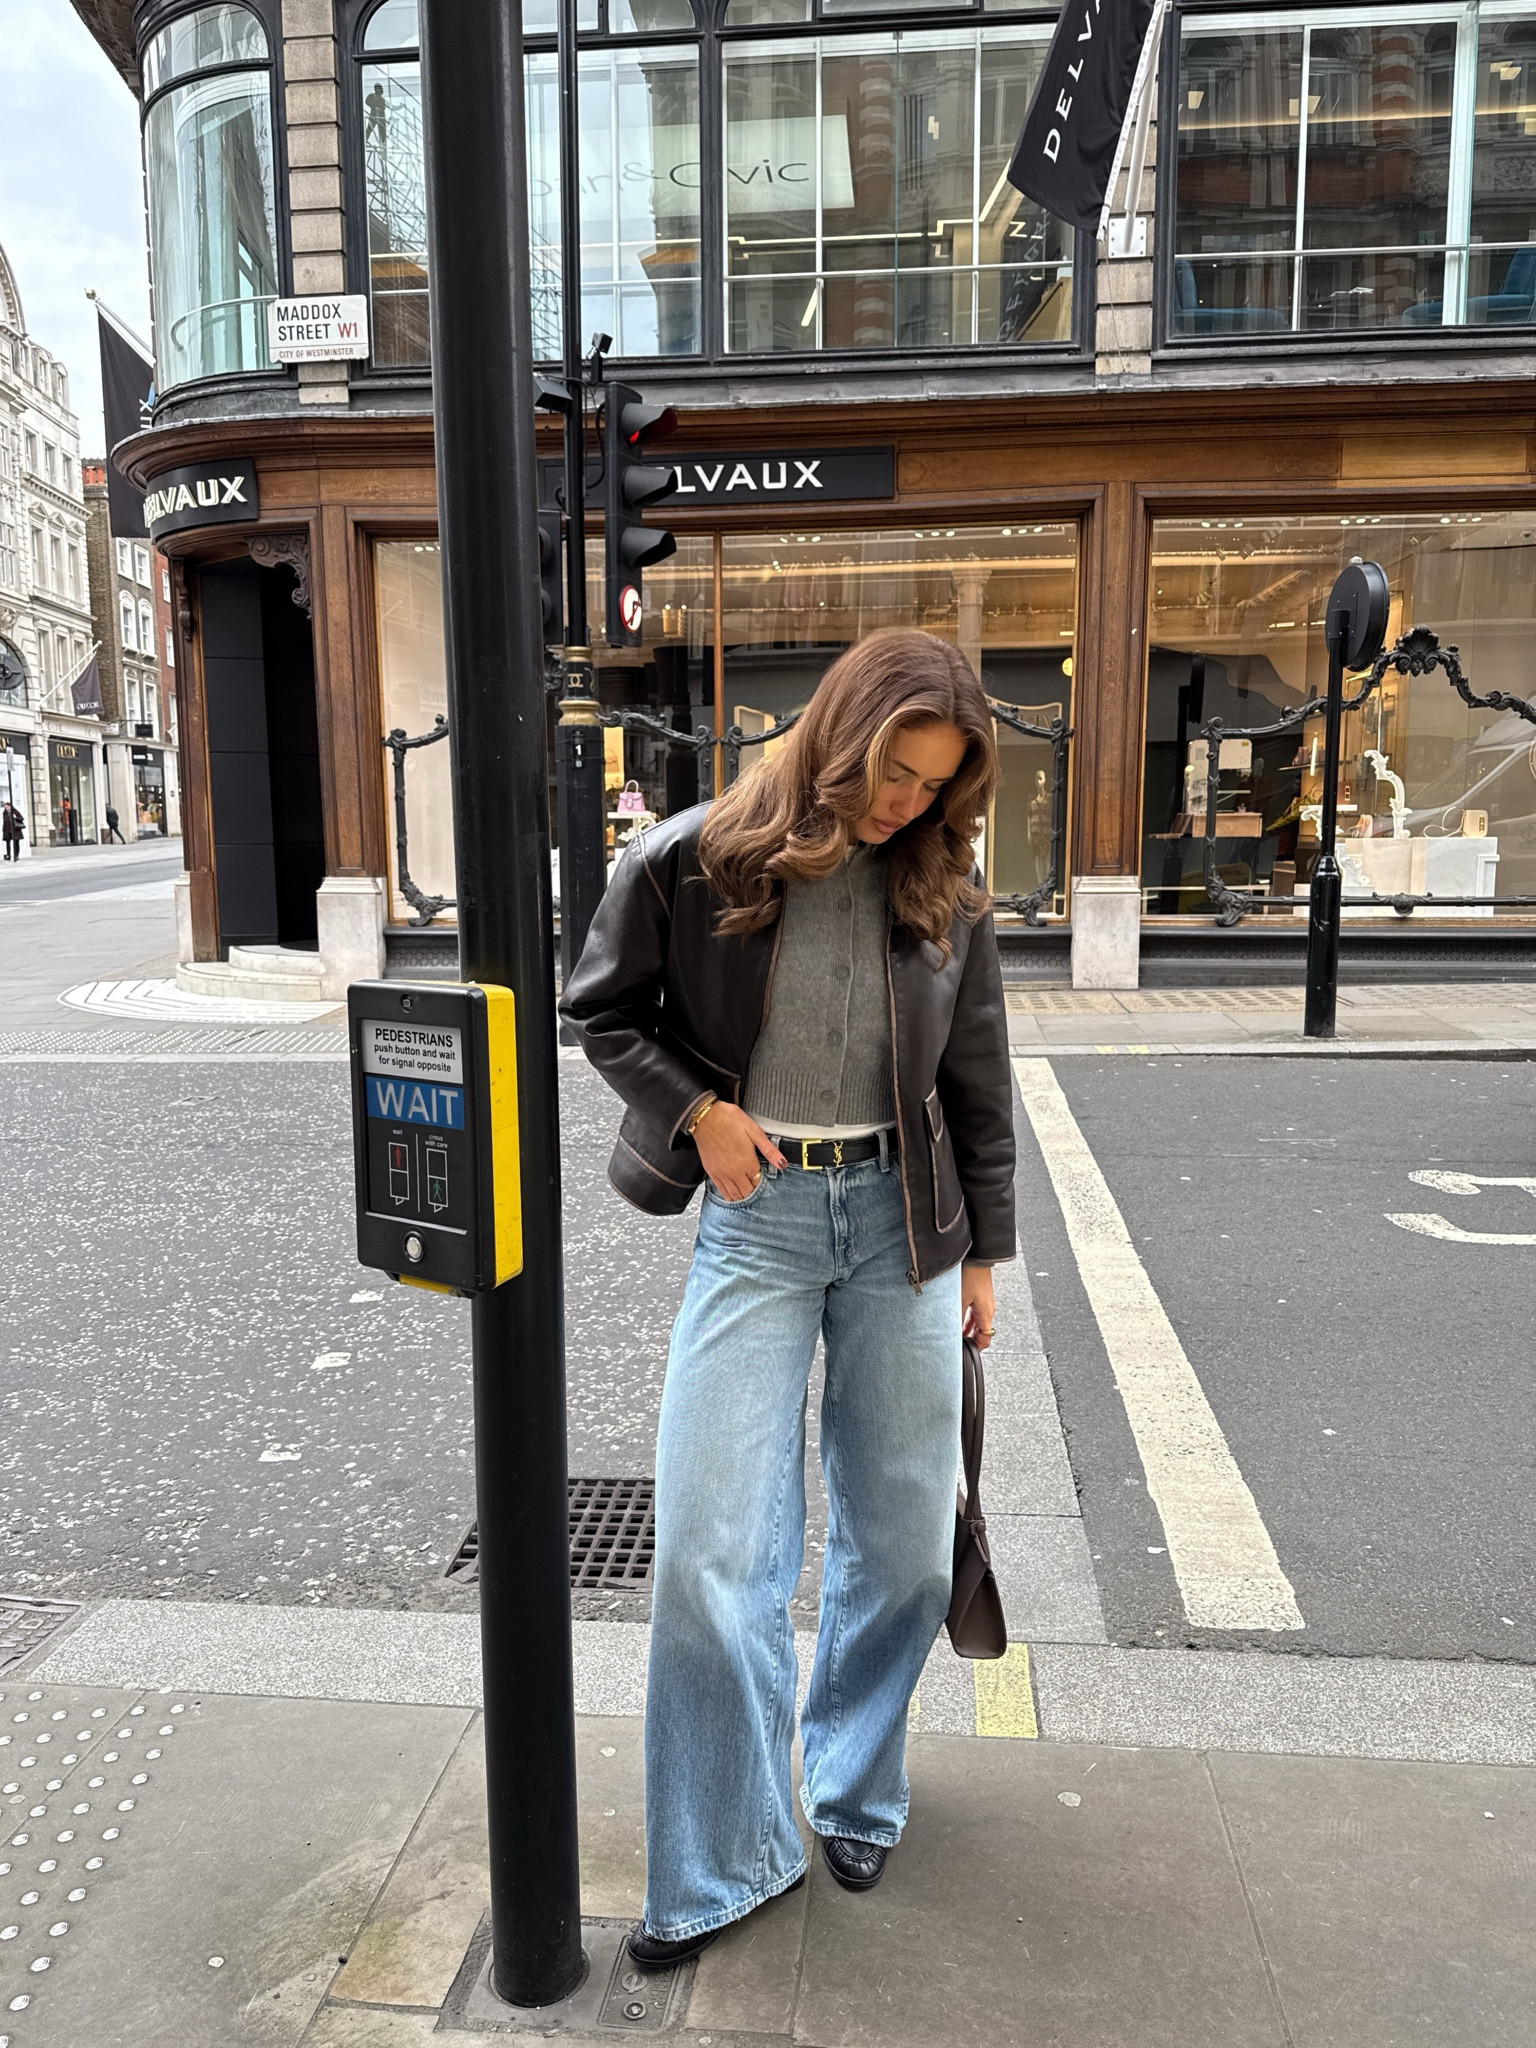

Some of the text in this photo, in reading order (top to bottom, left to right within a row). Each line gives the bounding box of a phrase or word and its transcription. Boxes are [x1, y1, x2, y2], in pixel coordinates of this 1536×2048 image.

[1043, 0, 1101, 164] DELV
[669, 159, 809, 188] Cvic
[277, 303, 342, 322] MADDOX
[278, 321, 358, 341] STREET W1
[279, 347, 354, 359] CITY OF WESTMINSTER
[655, 460, 824, 493] LVAUX
[375, 1028, 453, 1048] PEDESTRIANS
[374, 1044, 456, 1060] push button and wait
[379, 1055, 452, 1073] for signal opposite
[376, 1081, 458, 1125] WAIT
